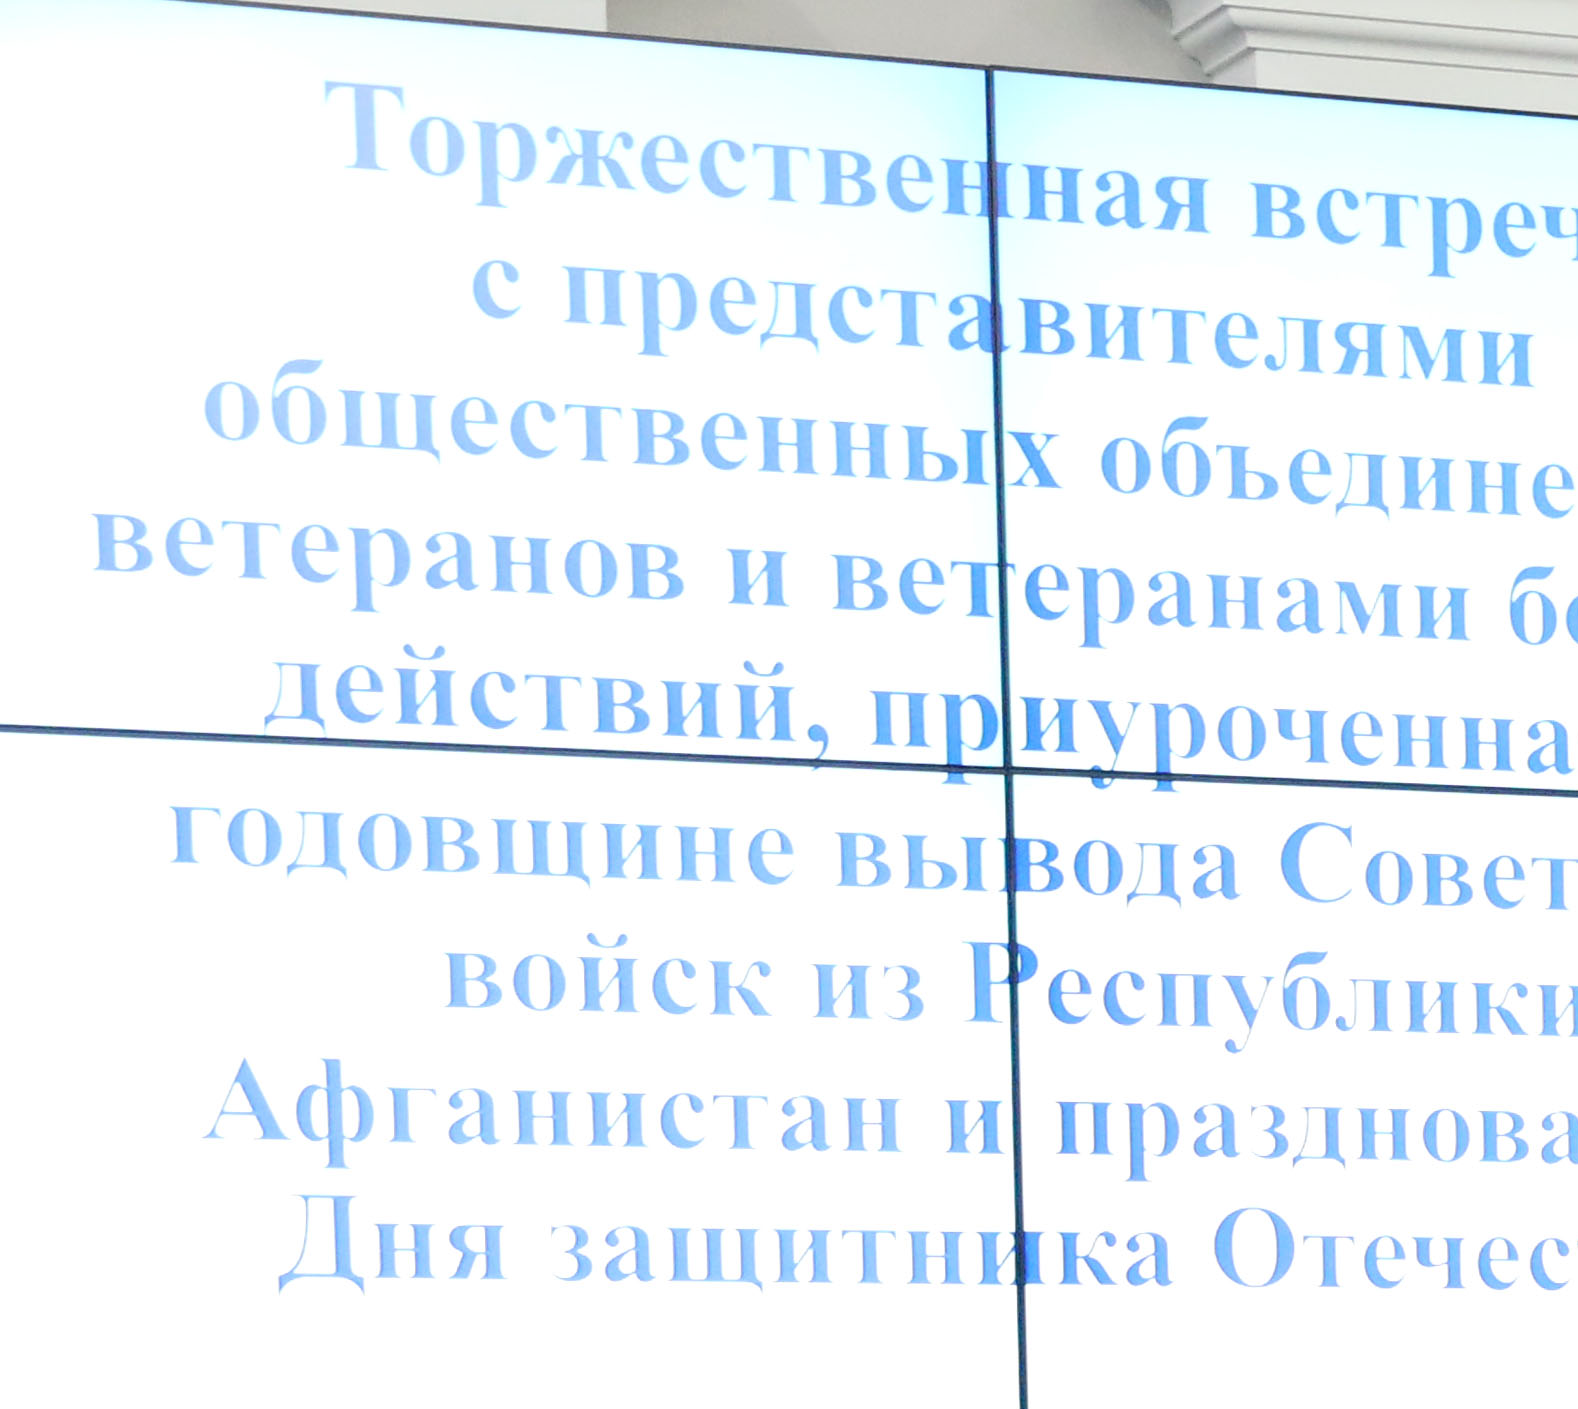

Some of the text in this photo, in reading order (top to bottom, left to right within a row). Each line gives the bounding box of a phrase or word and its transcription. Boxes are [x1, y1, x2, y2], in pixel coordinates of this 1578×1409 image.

[324, 80, 1211, 234] Торжественная
[472, 260, 1534, 387] с представителями
[205, 363, 1063, 488] общественных
[92, 514, 684, 611] ветеранов
[727, 548, 790, 607] и
[832, 554, 1470, 647] ветеранами
[264, 644, 829, 756] действий,
[170, 806, 794, 888] годовщине
[836, 832, 1240, 908] вывода
[445, 933, 772, 1016] войск
[813, 964, 924, 1021] из
[203, 1058, 901, 1169] Афганистан
[945, 1100, 1004, 1154] и
[278, 1194, 506, 1294] Дня
[557, 1225, 1173, 1291] защитника
